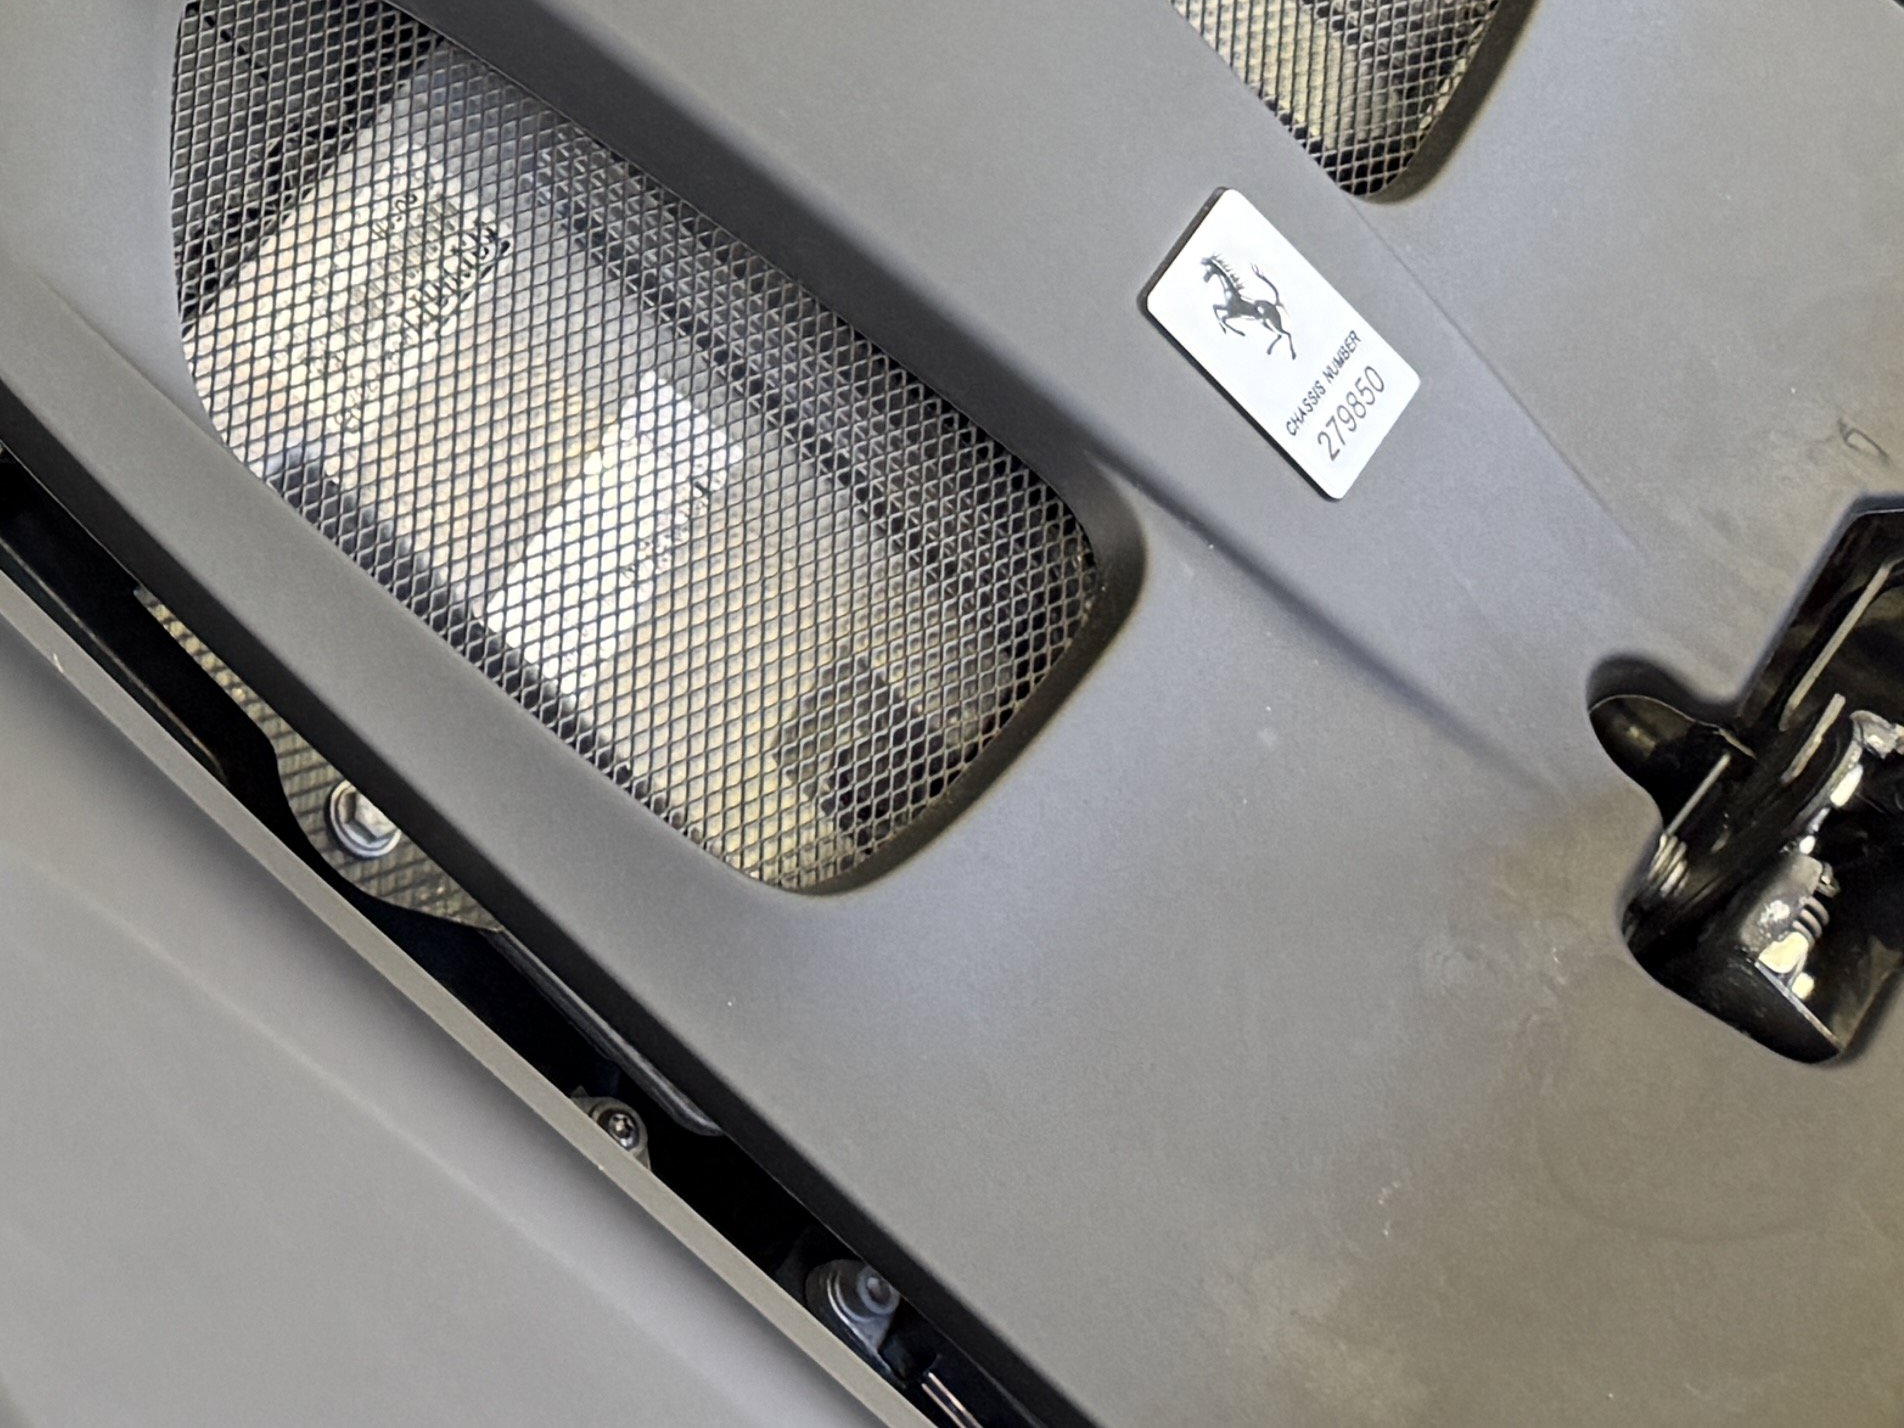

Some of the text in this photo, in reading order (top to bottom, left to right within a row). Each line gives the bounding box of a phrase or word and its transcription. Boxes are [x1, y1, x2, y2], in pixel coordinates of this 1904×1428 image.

[1285, 329, 1363, 437] CHASSIS NUMBER
[1317, 366, 1385, 462] 279850
